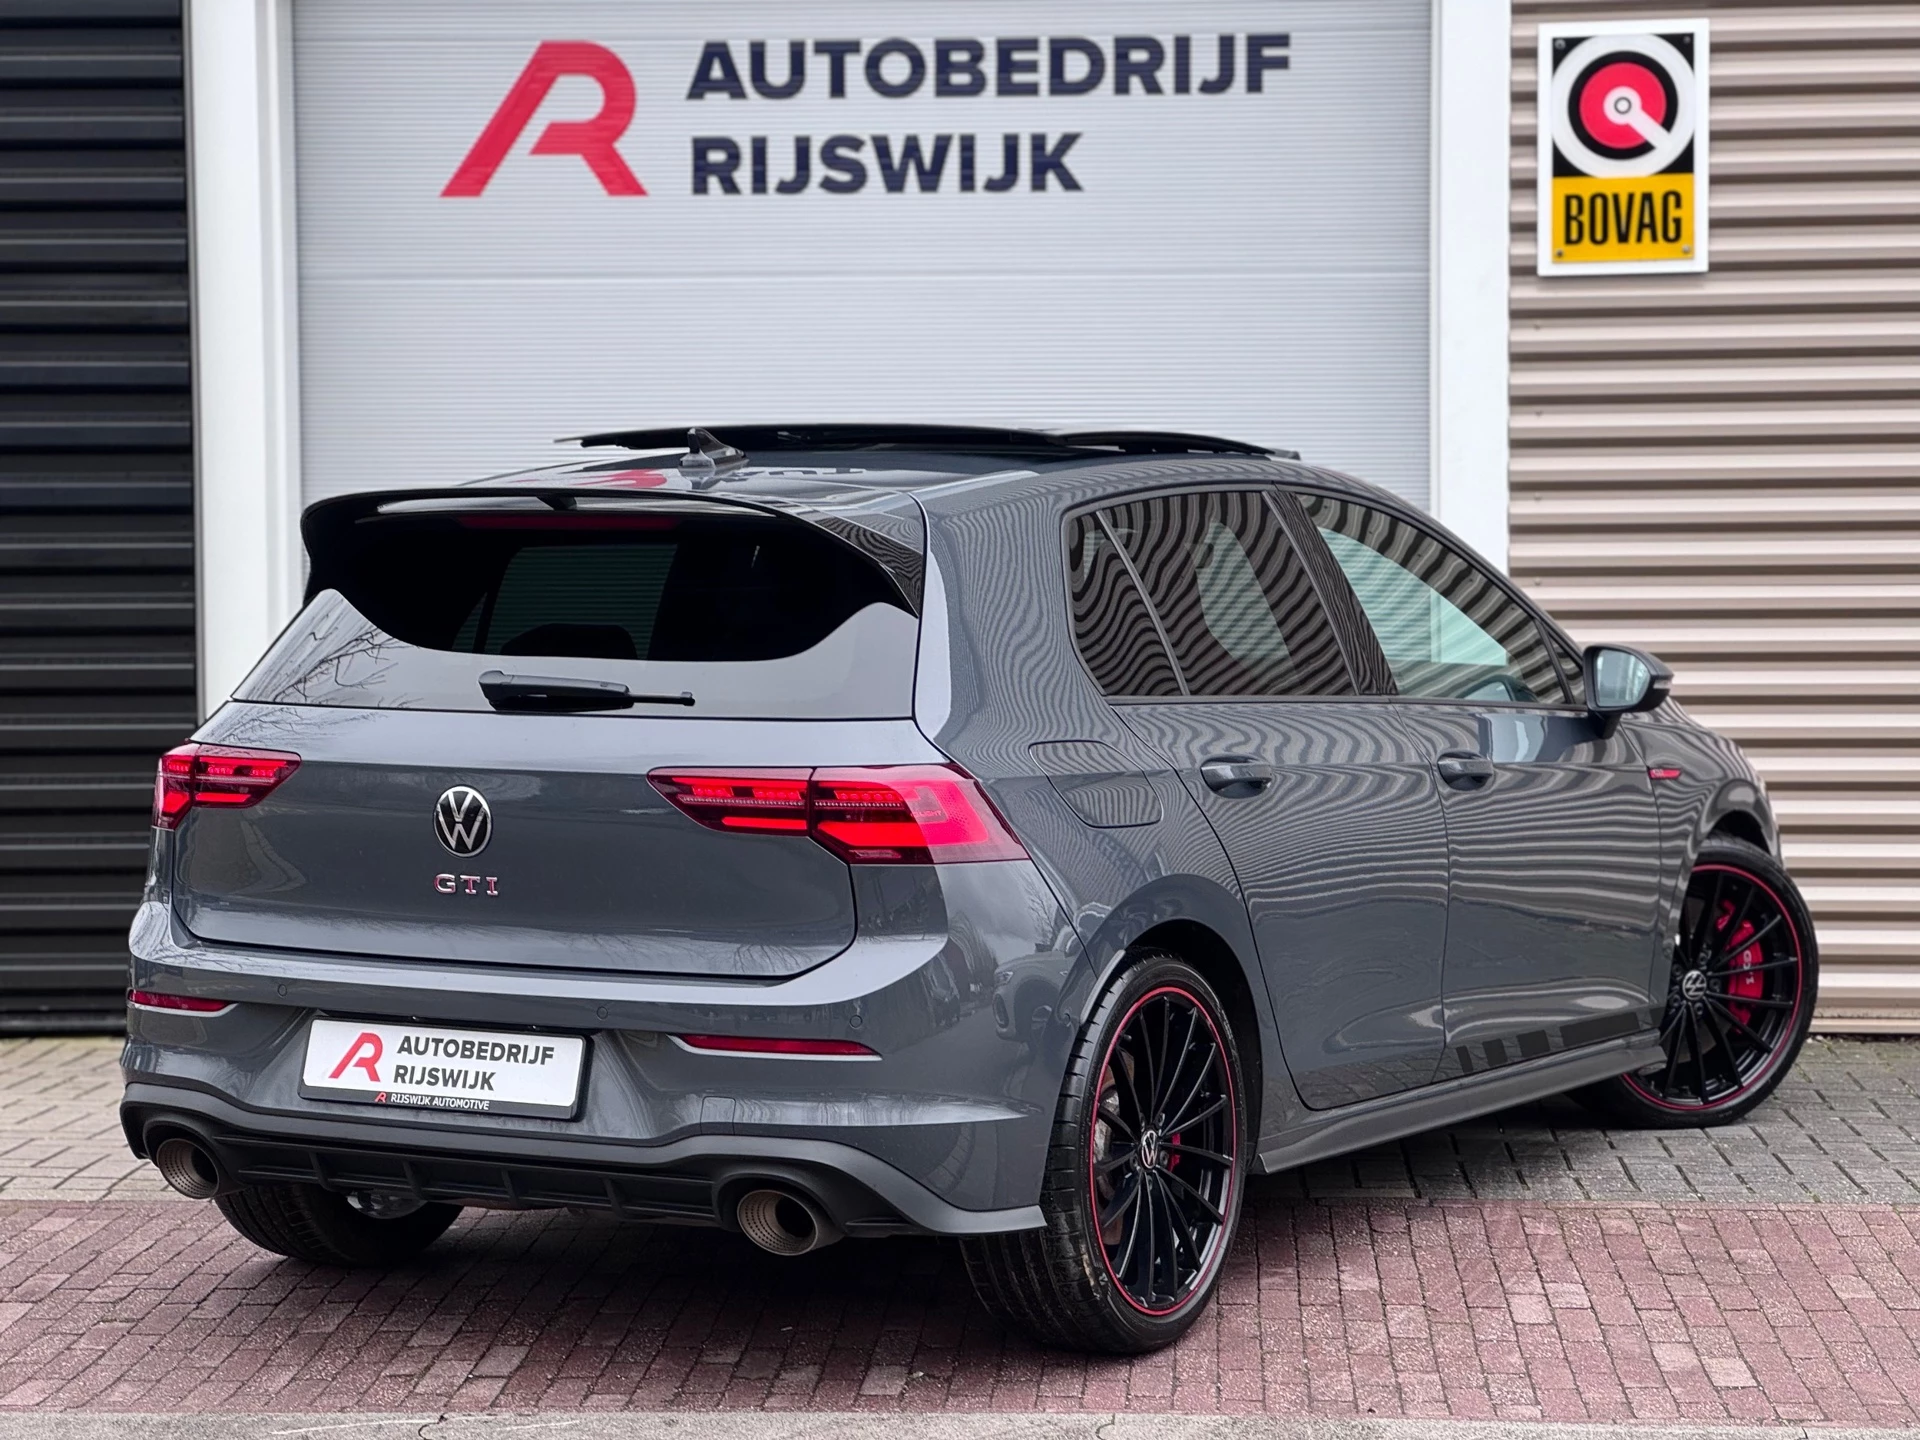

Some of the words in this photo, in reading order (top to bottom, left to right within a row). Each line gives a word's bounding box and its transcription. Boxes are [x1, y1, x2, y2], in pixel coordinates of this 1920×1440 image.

[686, 33, 1291, 101] AUTOBEDRIJF
[690, 132, 1083, 196] RIJSWIJK
[1564, 190, 1682, 246] BOVAG
[434, 873, 499, 896] GTI
[397, 1035, 555, 1066] AUTOBEDRIJF
[393, 1065, 496, 1091] RIJSWIJK
[390, 1093, 431, 1106] RIJSWIJK
[432, 1096, 490, 1110] AUTOMOTIVE
